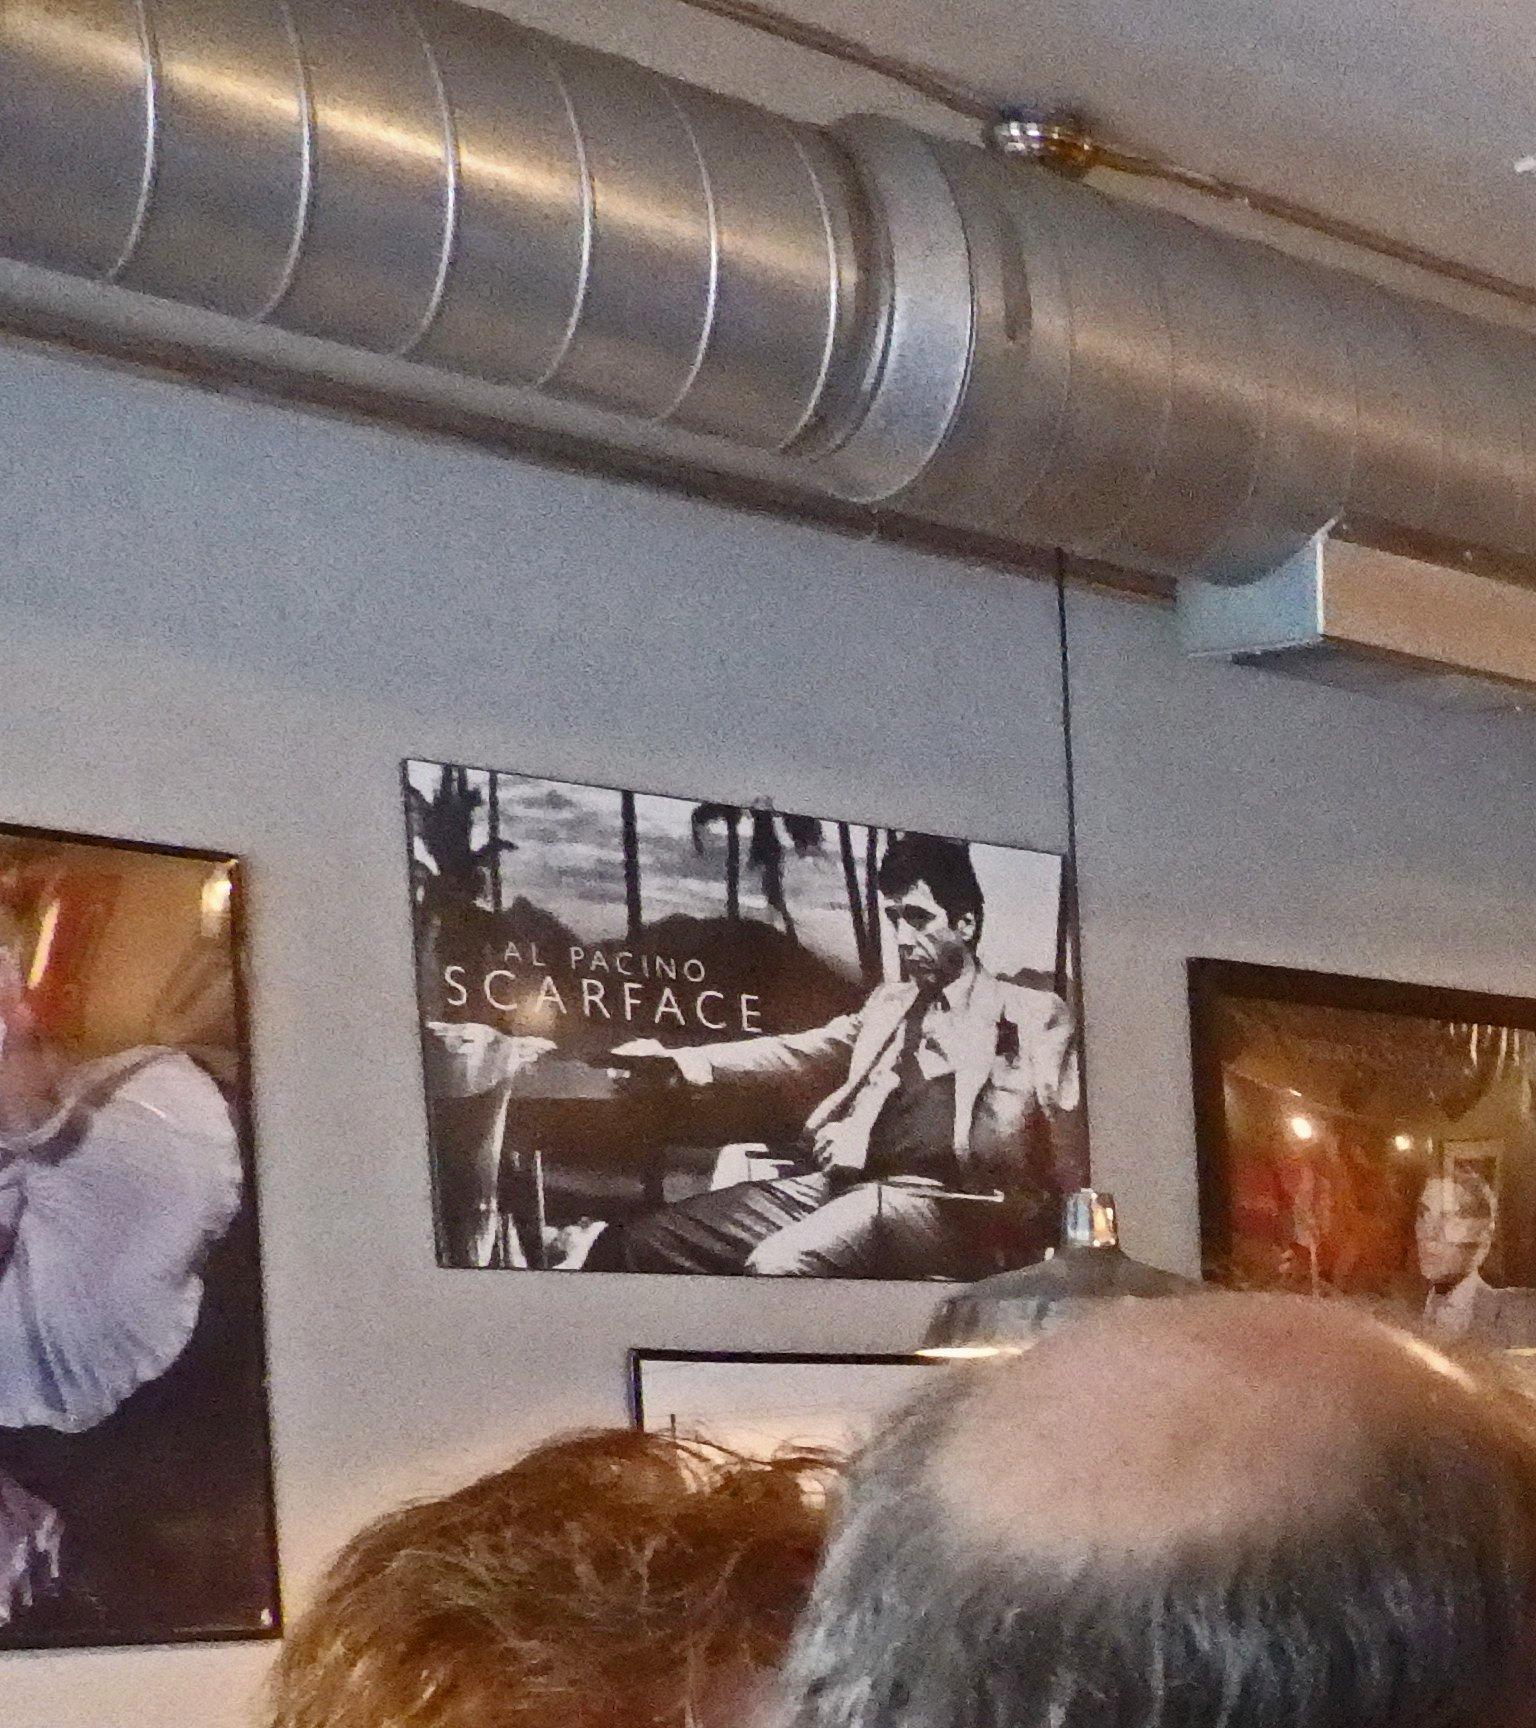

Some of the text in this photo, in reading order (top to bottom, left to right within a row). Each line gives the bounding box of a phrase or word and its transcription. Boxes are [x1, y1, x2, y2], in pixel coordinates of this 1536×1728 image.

[503, 941, 706, 983] AL PACINO
[443, 965, 763, 1034] SCARFACE
